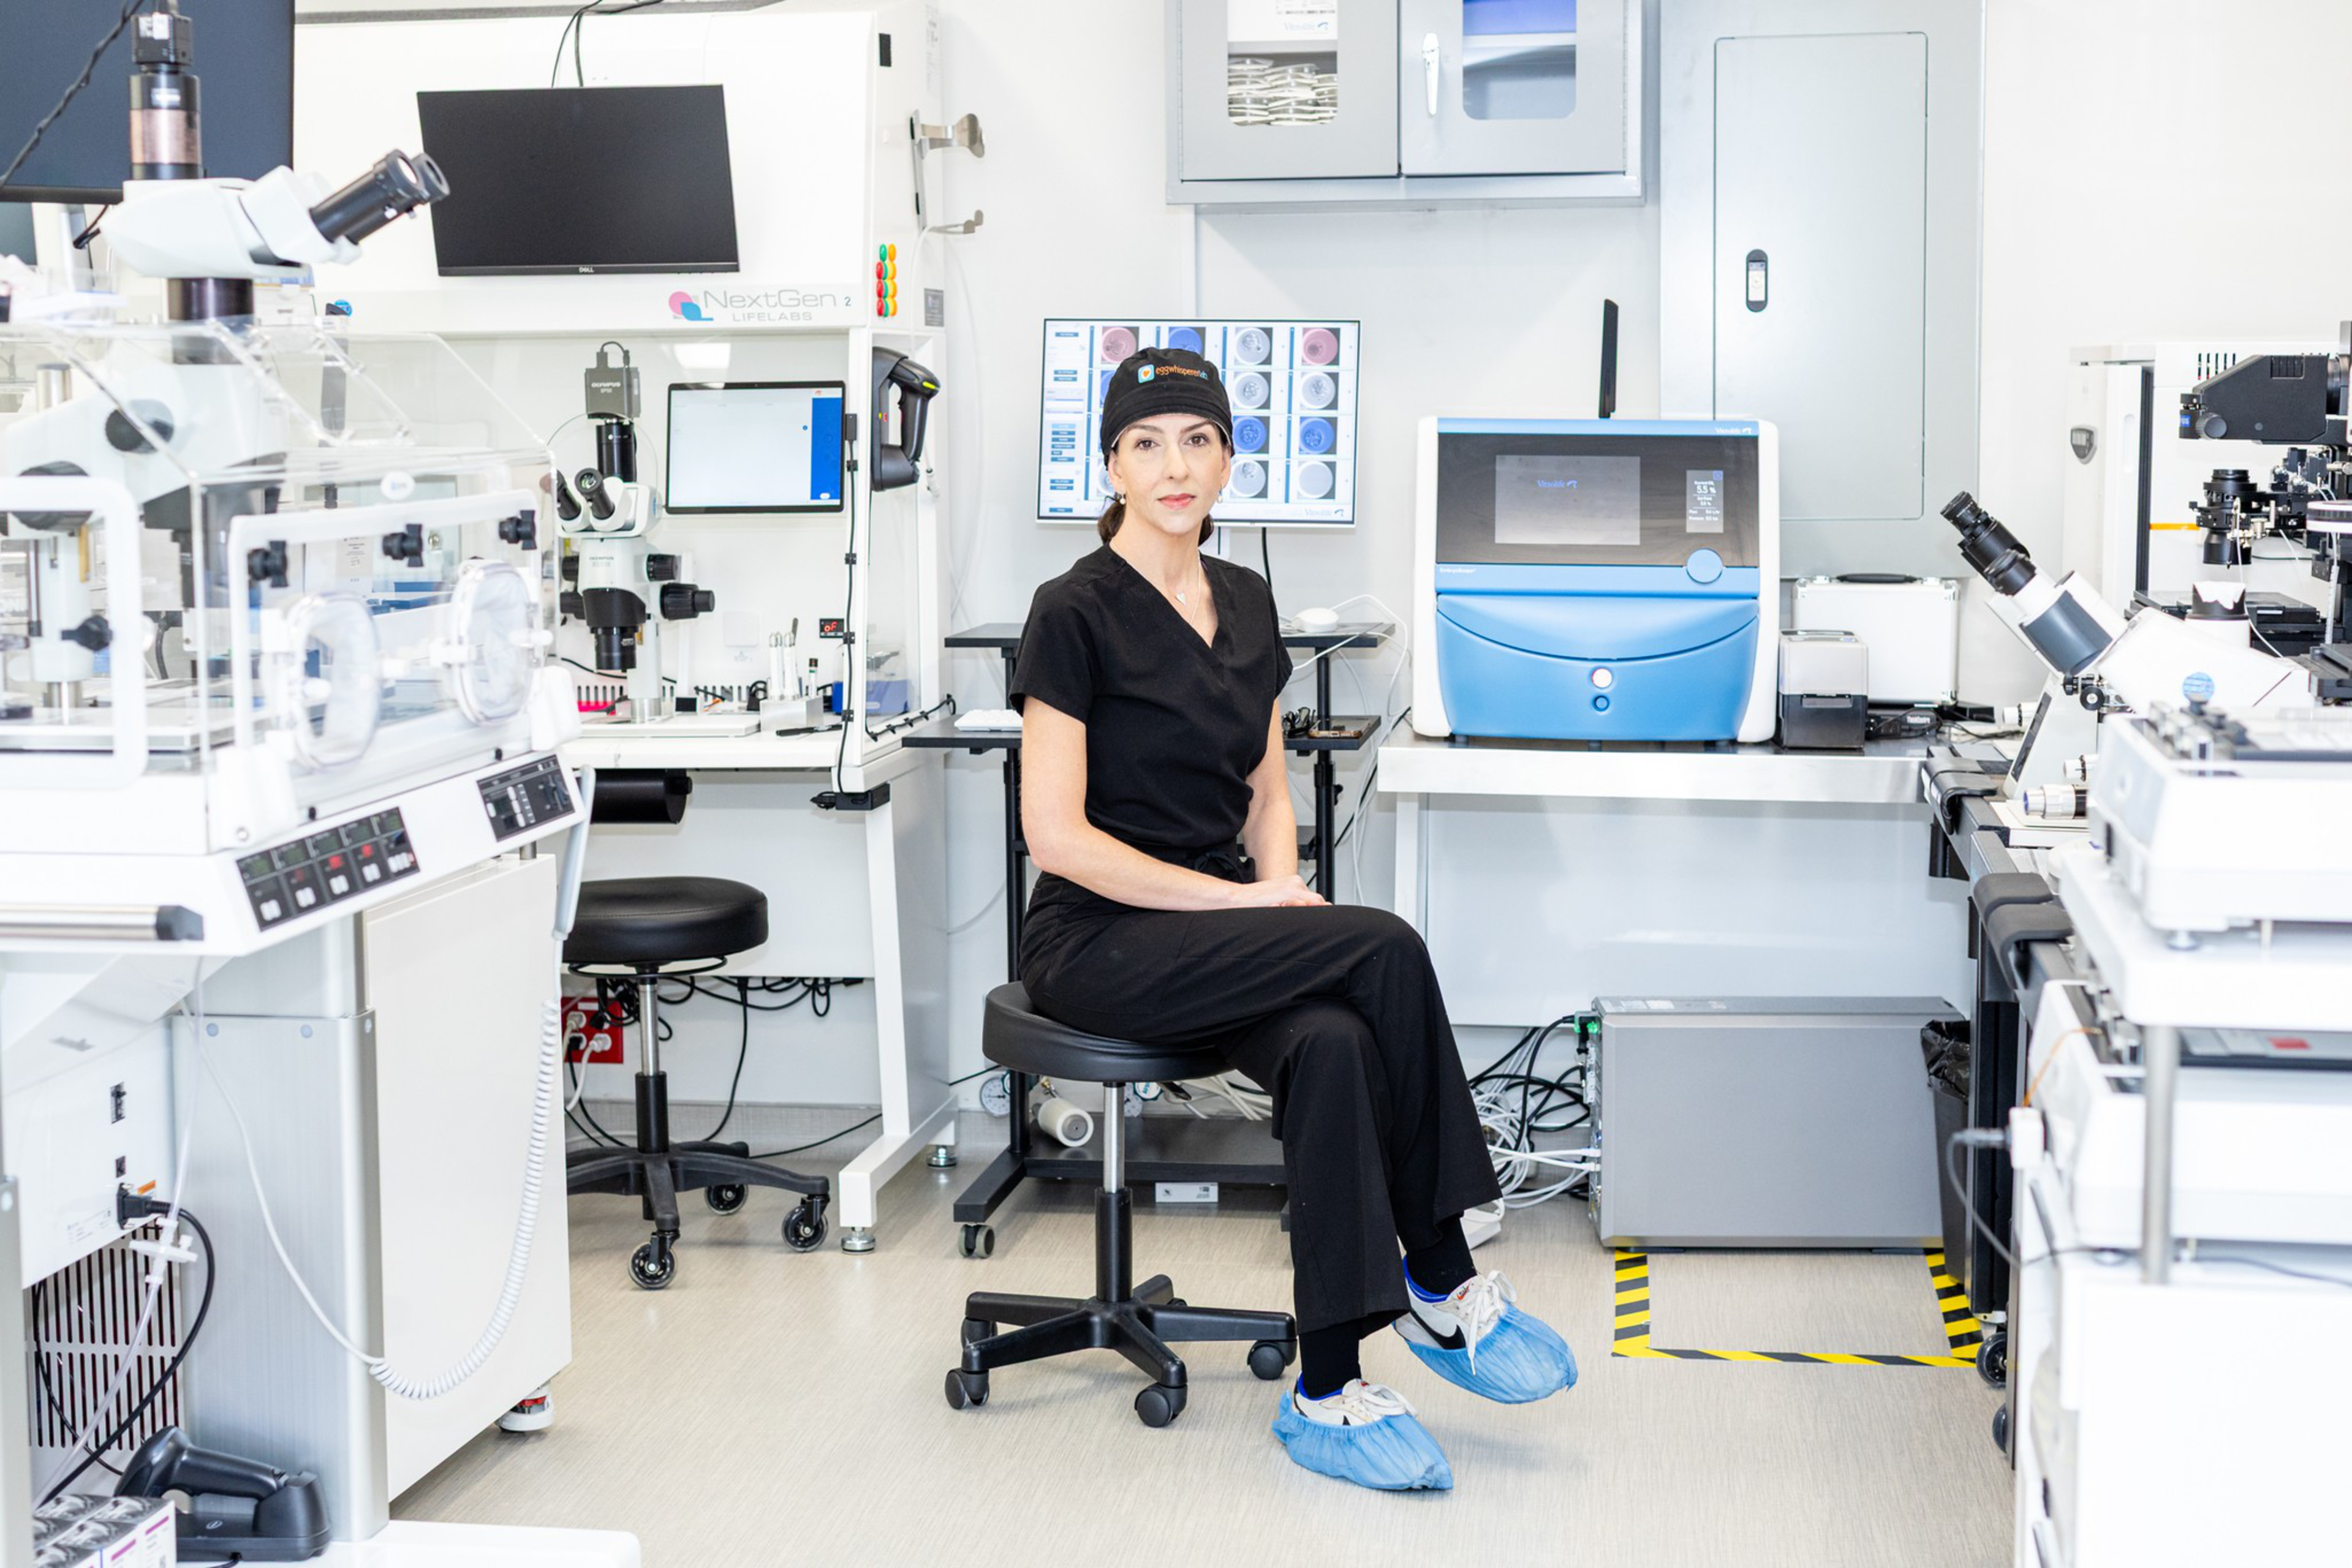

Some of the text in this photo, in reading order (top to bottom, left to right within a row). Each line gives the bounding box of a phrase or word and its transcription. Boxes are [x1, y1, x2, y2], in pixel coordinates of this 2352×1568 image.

[703, 289, 837, 309] NextGen
[844, 296, 852, 306] 2
[733, 312, 813, 322] LIFELABS
[1537, 480, 1565, 488] Vitrolife
